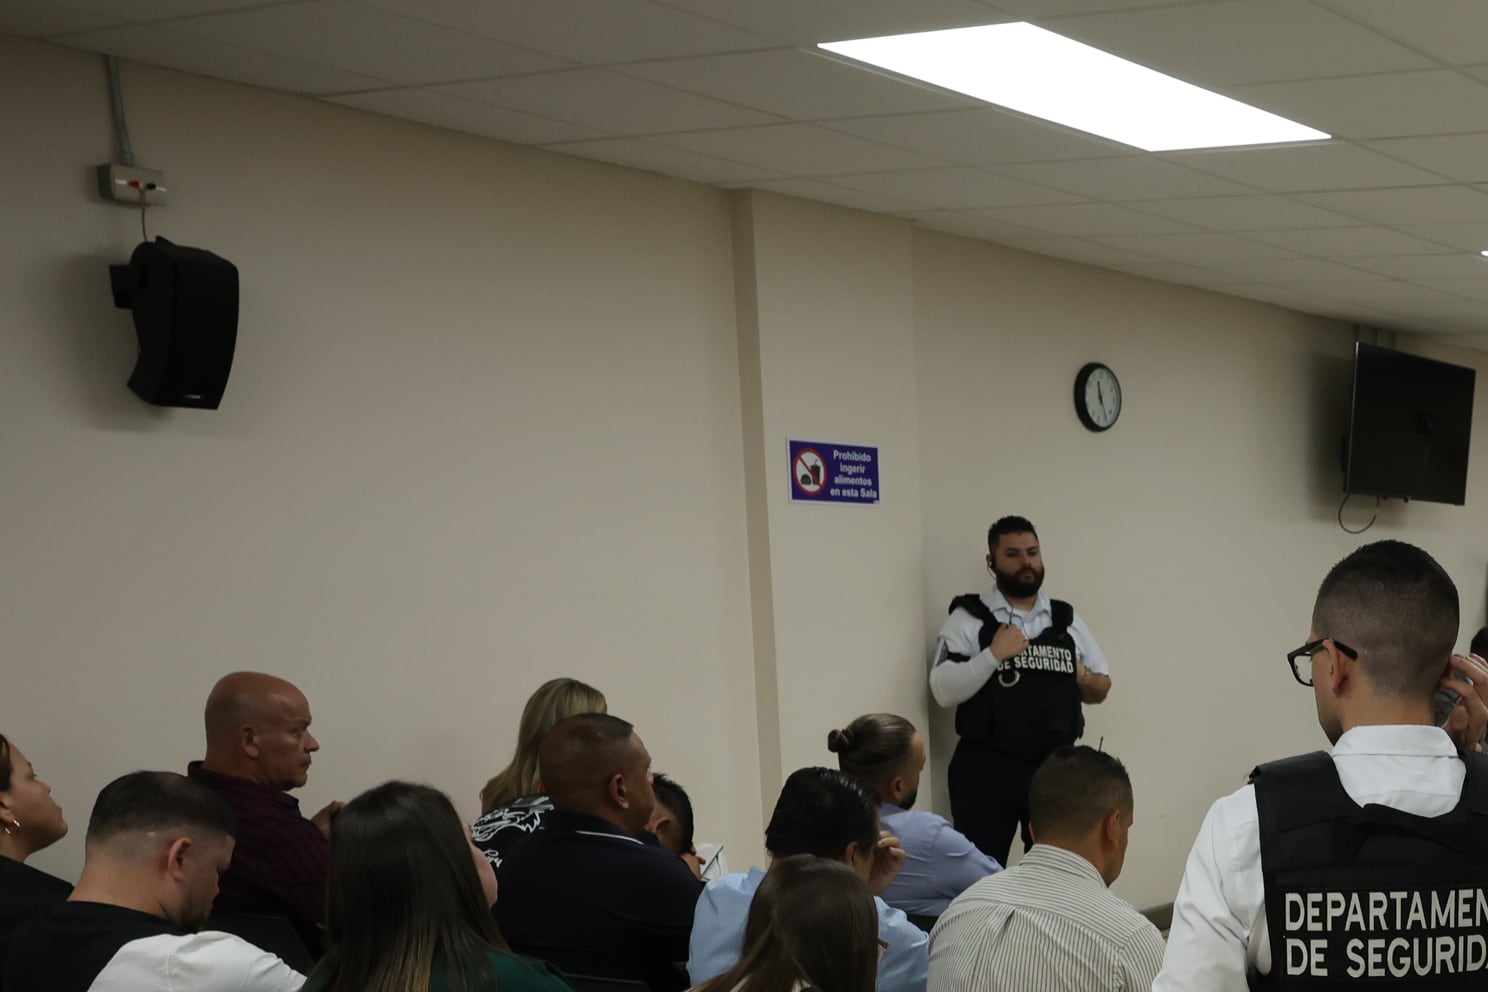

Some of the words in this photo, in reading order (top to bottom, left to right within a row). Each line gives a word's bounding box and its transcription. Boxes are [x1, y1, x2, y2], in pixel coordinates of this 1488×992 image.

[833, 449, 871, 462] Prohibido
[834, 475, 872, 486] alimentos
[830, 488, 840, 497] en
[842, 488, 859, 497] esta
[1014, 656, 1074, 673] SEGURIDAD
[1286, 938, 1328, 976] DE
